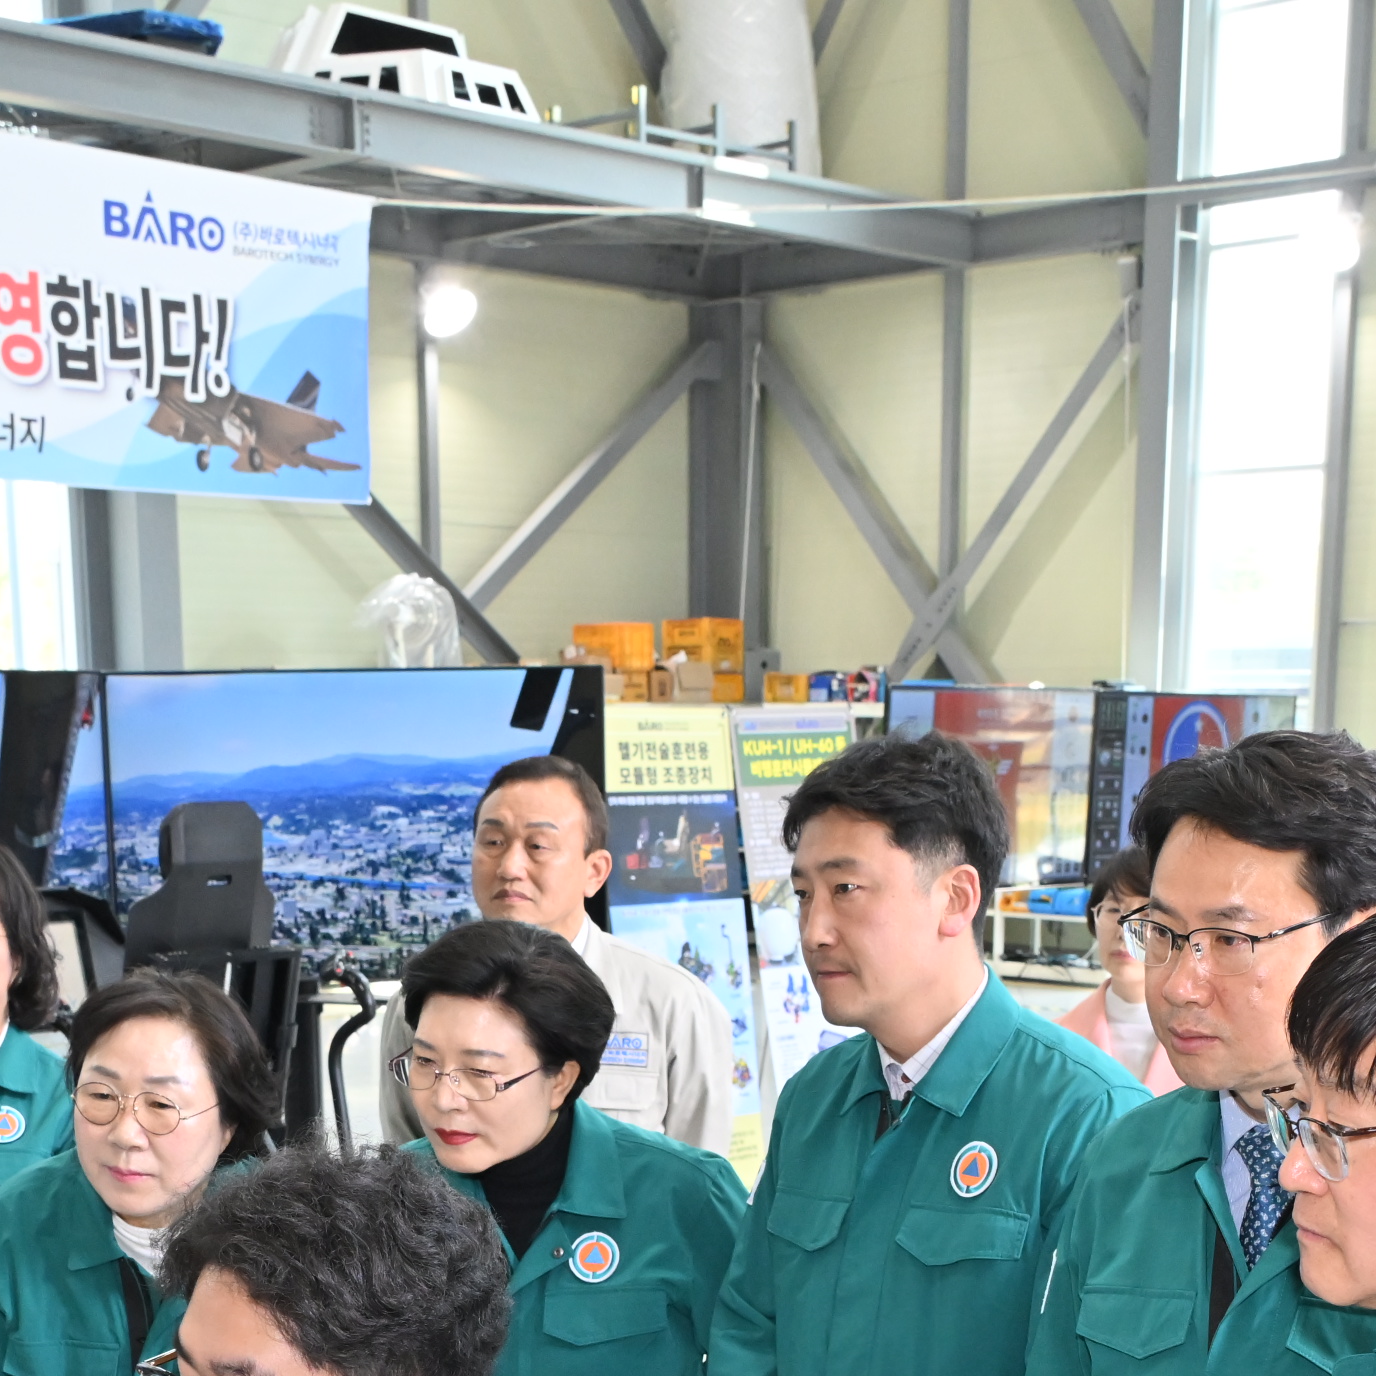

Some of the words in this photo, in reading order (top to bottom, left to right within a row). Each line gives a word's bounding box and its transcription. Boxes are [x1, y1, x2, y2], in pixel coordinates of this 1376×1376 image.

[104, 190, 224, 252] BARO
[232, 219, 340, 253] (주)바로텍시너지
[232, 244, 295, 263] BAROTECH
[296, 250, 340, 268] SYNERGY
[618, 741, 709, 761] 헬기전술훈련용
[620, 766, 657, 785] 모듈형
[663, 765, 713, 785] 조종장치
